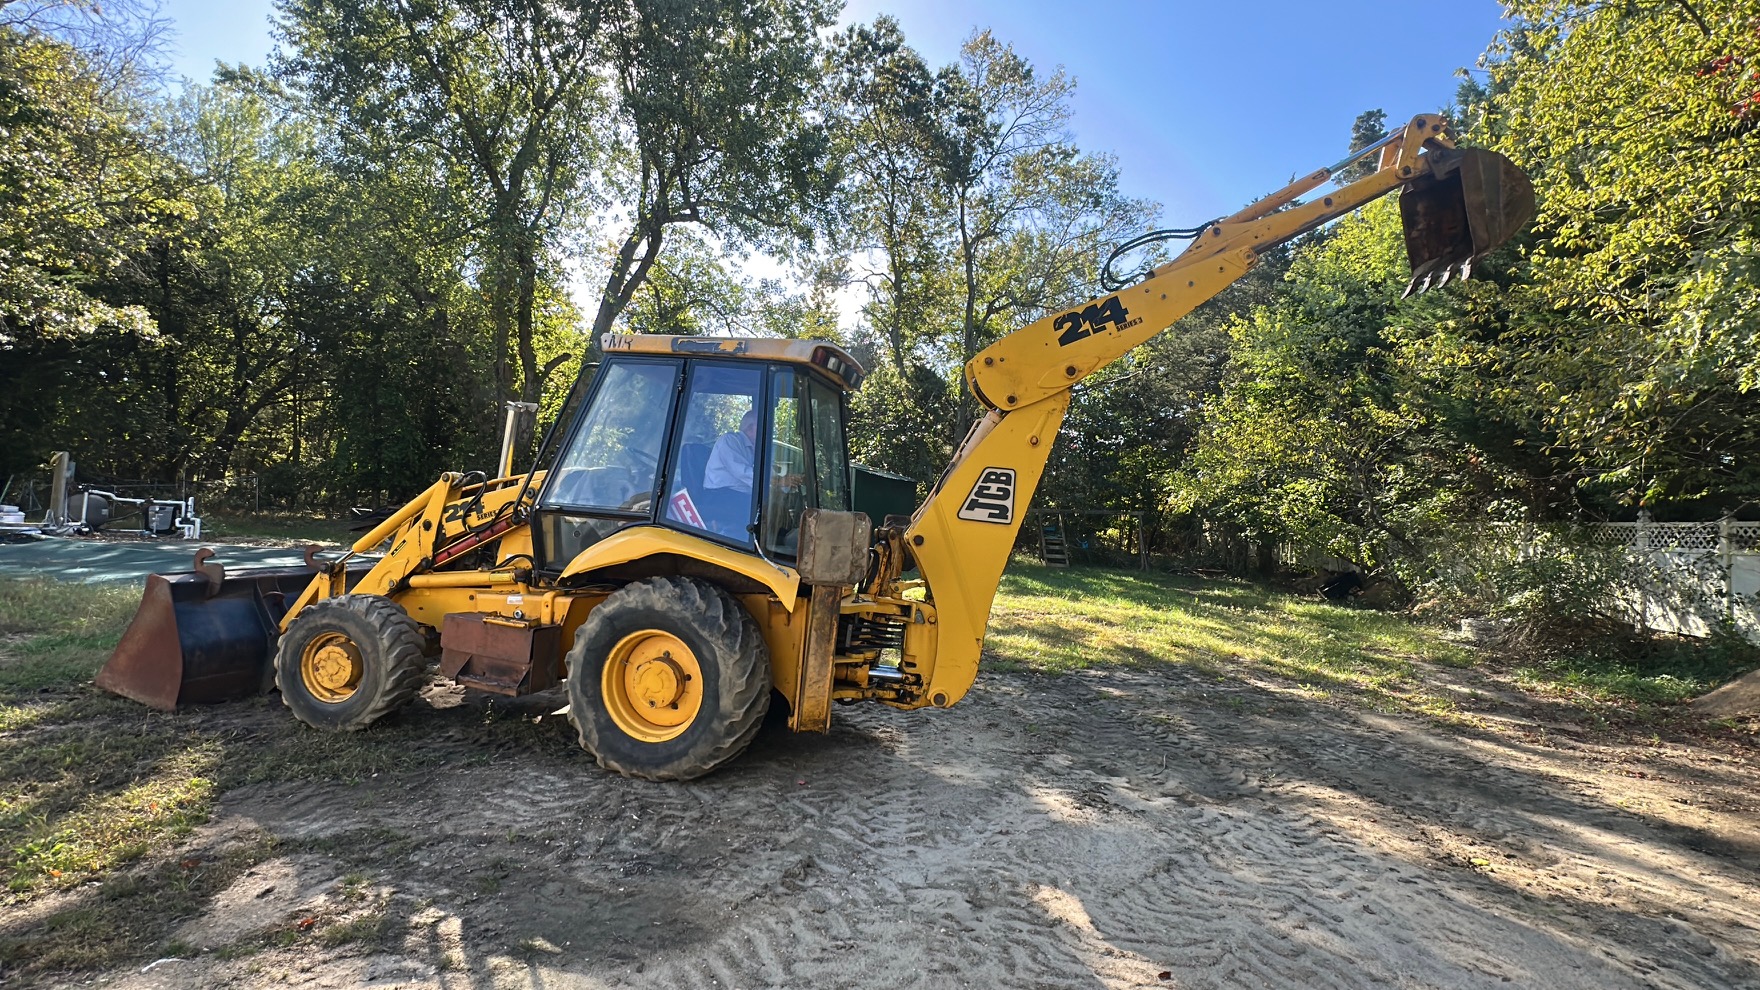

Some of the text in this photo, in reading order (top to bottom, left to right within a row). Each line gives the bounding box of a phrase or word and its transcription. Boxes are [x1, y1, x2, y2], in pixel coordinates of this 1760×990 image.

[1053, 296, 1129, 347] 214
[1116, 320, 1138, 332] SERIES
[965, 471, 1012, 520] JCB
